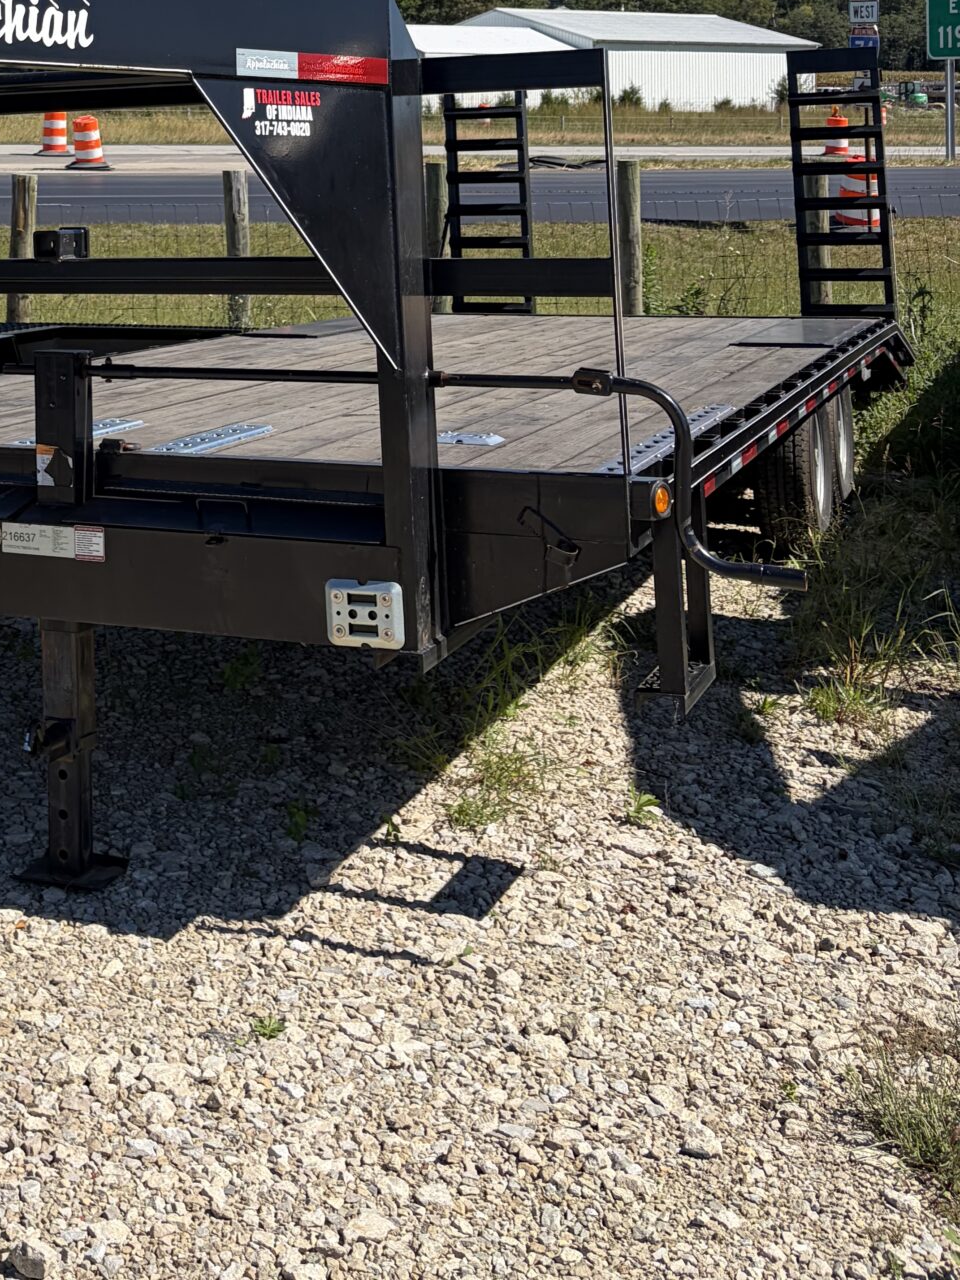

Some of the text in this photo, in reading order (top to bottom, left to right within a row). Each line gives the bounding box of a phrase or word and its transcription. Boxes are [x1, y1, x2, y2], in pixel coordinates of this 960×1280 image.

[852, 5, 875, 19] WEST
[246, 57, 290, 71] Appalachian
[255, 88, 321, 106] TRAILER SALES
[266, 104, 314, 121] OF INDIANA
[254, 120, 311, 137] 317-743-0020
